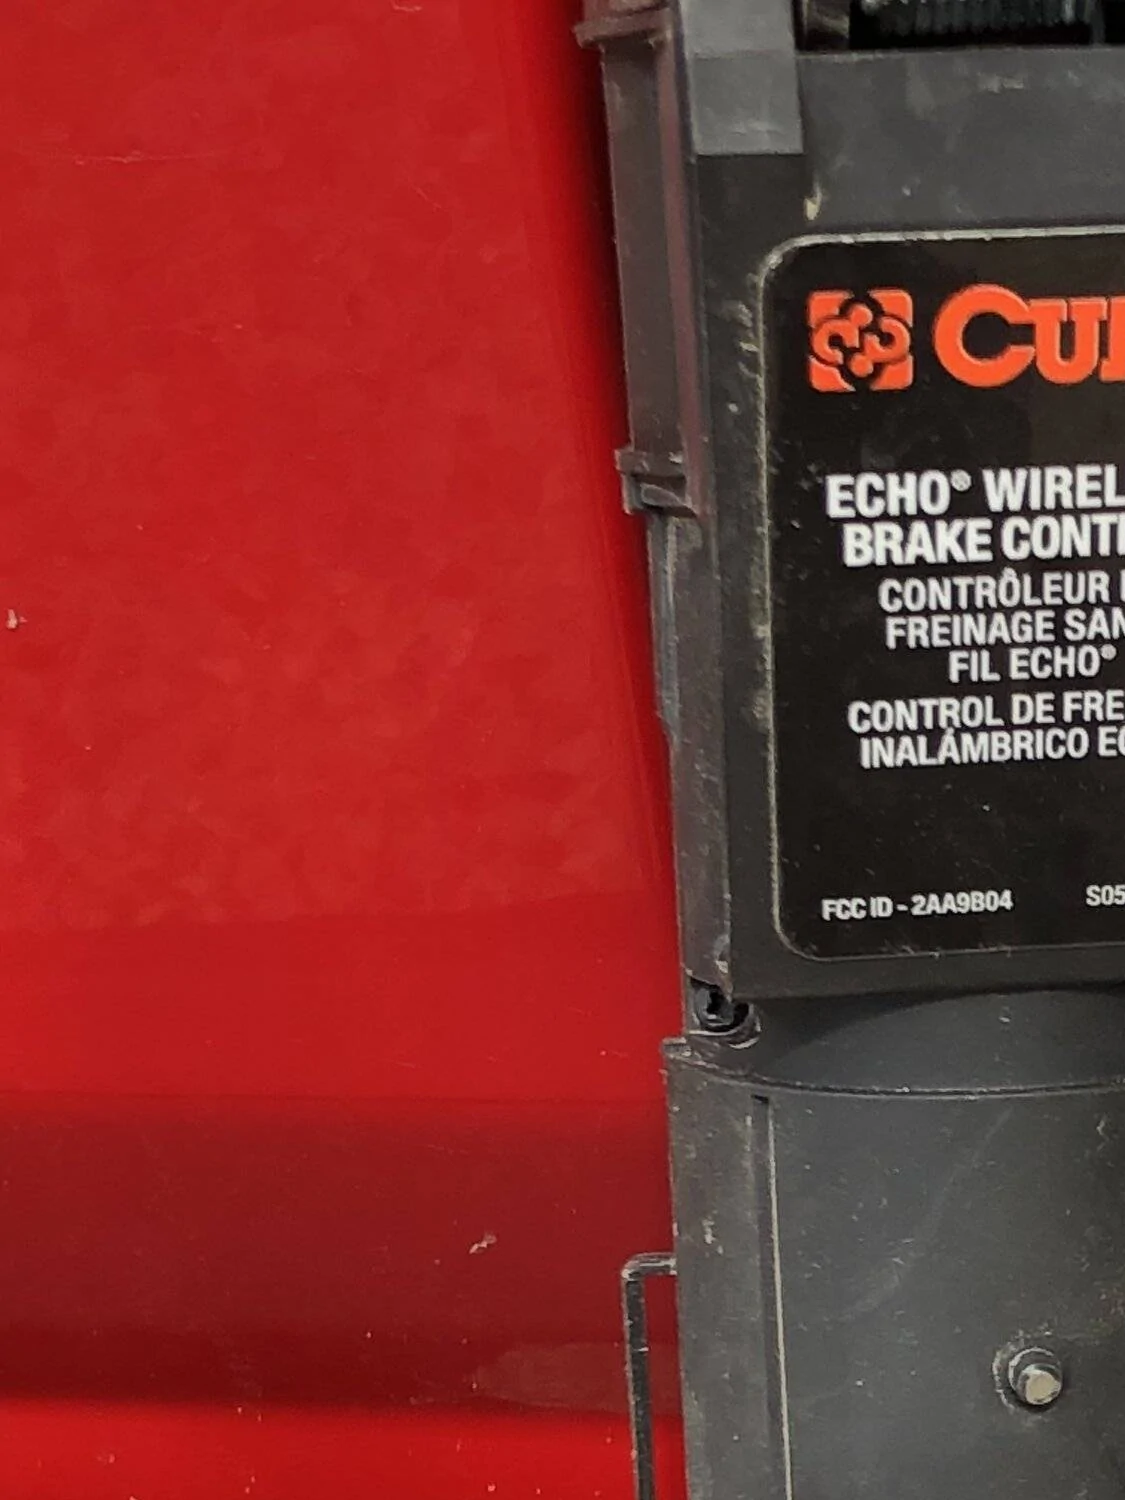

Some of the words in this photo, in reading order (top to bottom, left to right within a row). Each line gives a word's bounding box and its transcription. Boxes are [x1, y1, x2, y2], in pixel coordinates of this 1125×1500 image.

[841, 518, 993, 566] BRAKE
[877, 567, 1110, 612] CONTRÔLEUR
[885, 613, 1056, 649] FREINAGE
[948, 650, 1001, 683] FIL
[846, 696, 1005, 734] CONTROL
[1011, 691, 1056, 725] DE
[859, 726, 1089, 769] INALÁMBRICO
[821, 898, 868, 922] FCC
[869, 896, 894, 919] ID
